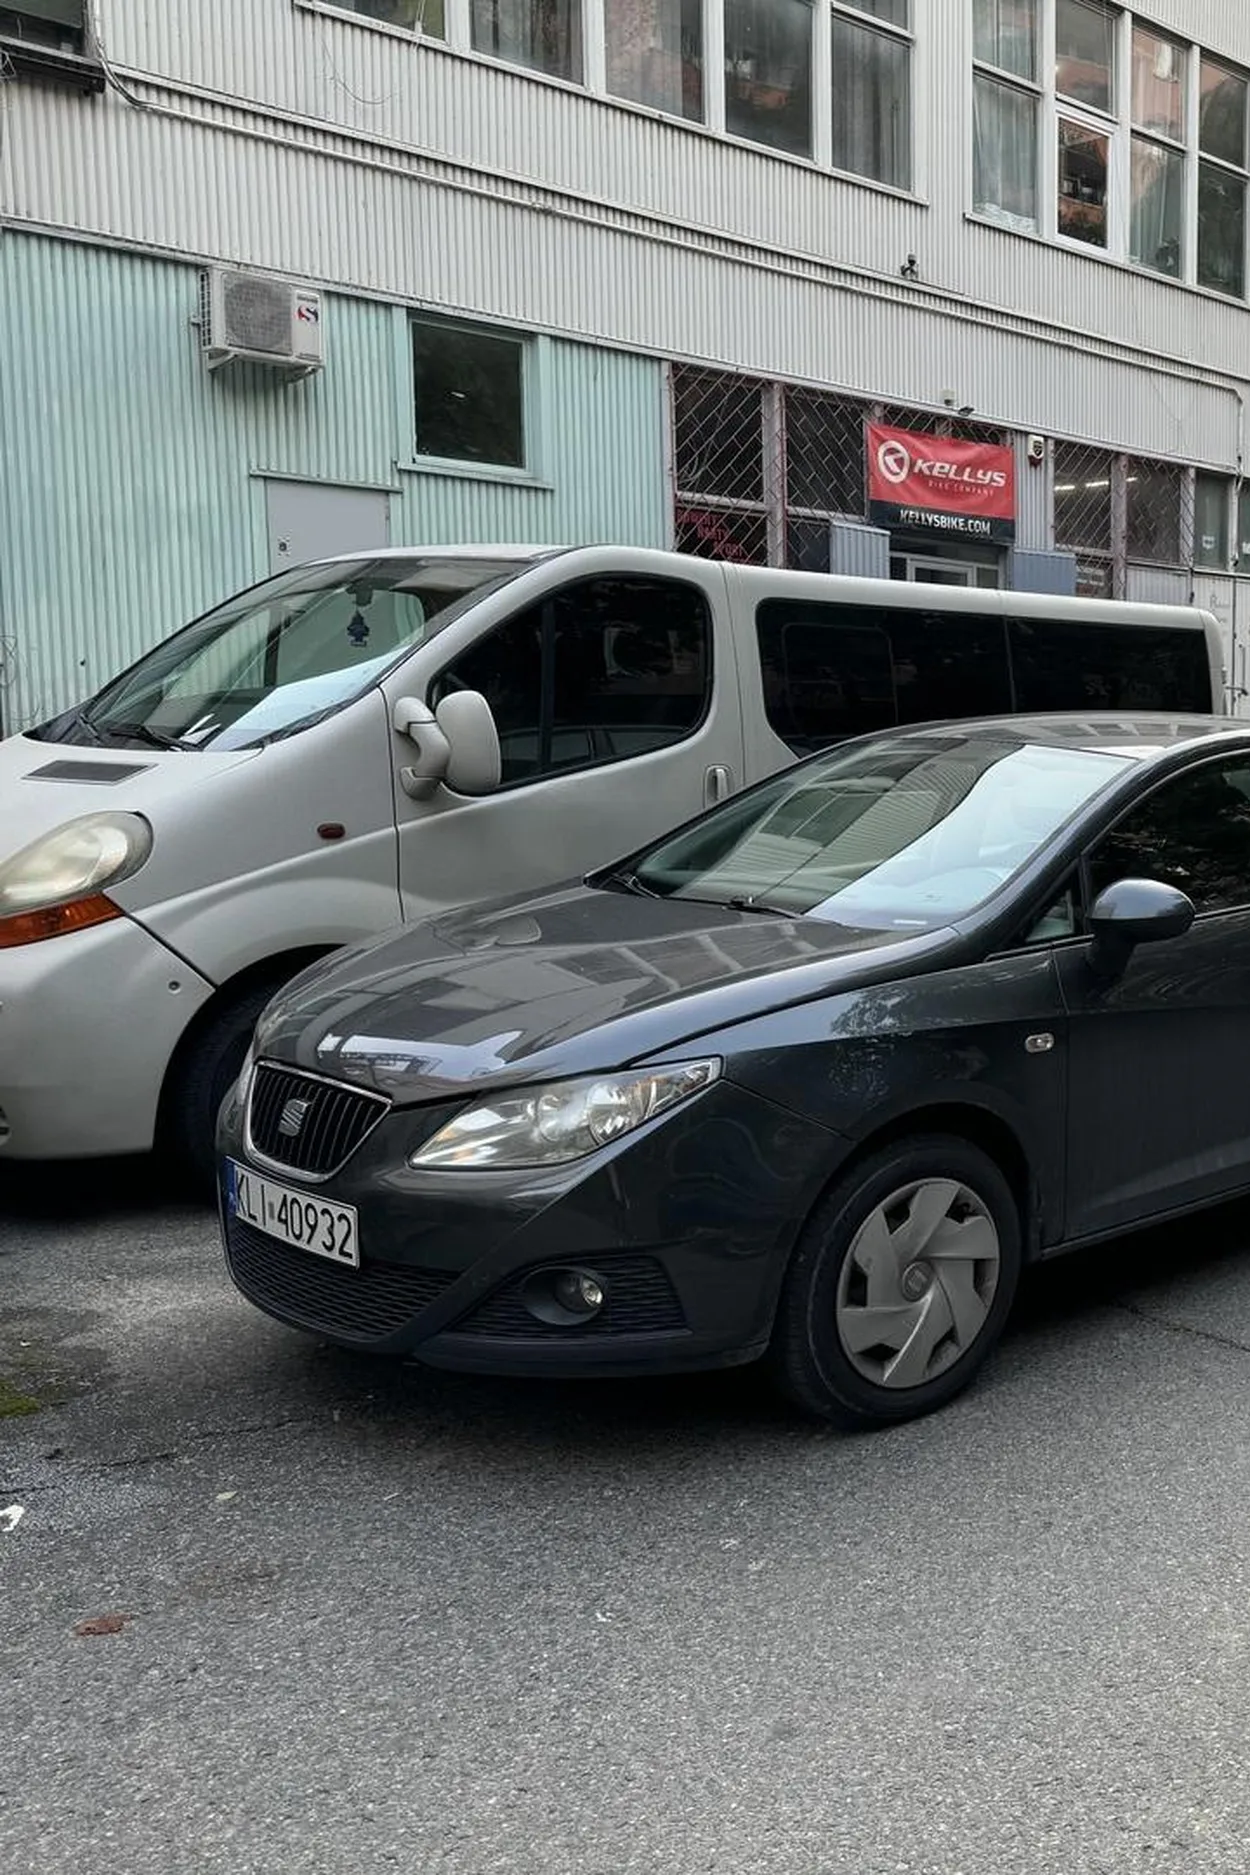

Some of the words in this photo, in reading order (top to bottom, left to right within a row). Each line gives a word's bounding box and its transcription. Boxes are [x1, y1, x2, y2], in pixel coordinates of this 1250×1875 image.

[913, 458, 1007, 487] KELLYS
[954, 483, 994, 497] COMPANY
[900, 509, 991, 535] KELLYSBIKE.COM
[235, 1168, 267, 1228] KLI
[277, 1194, 353, 1260] 40932
